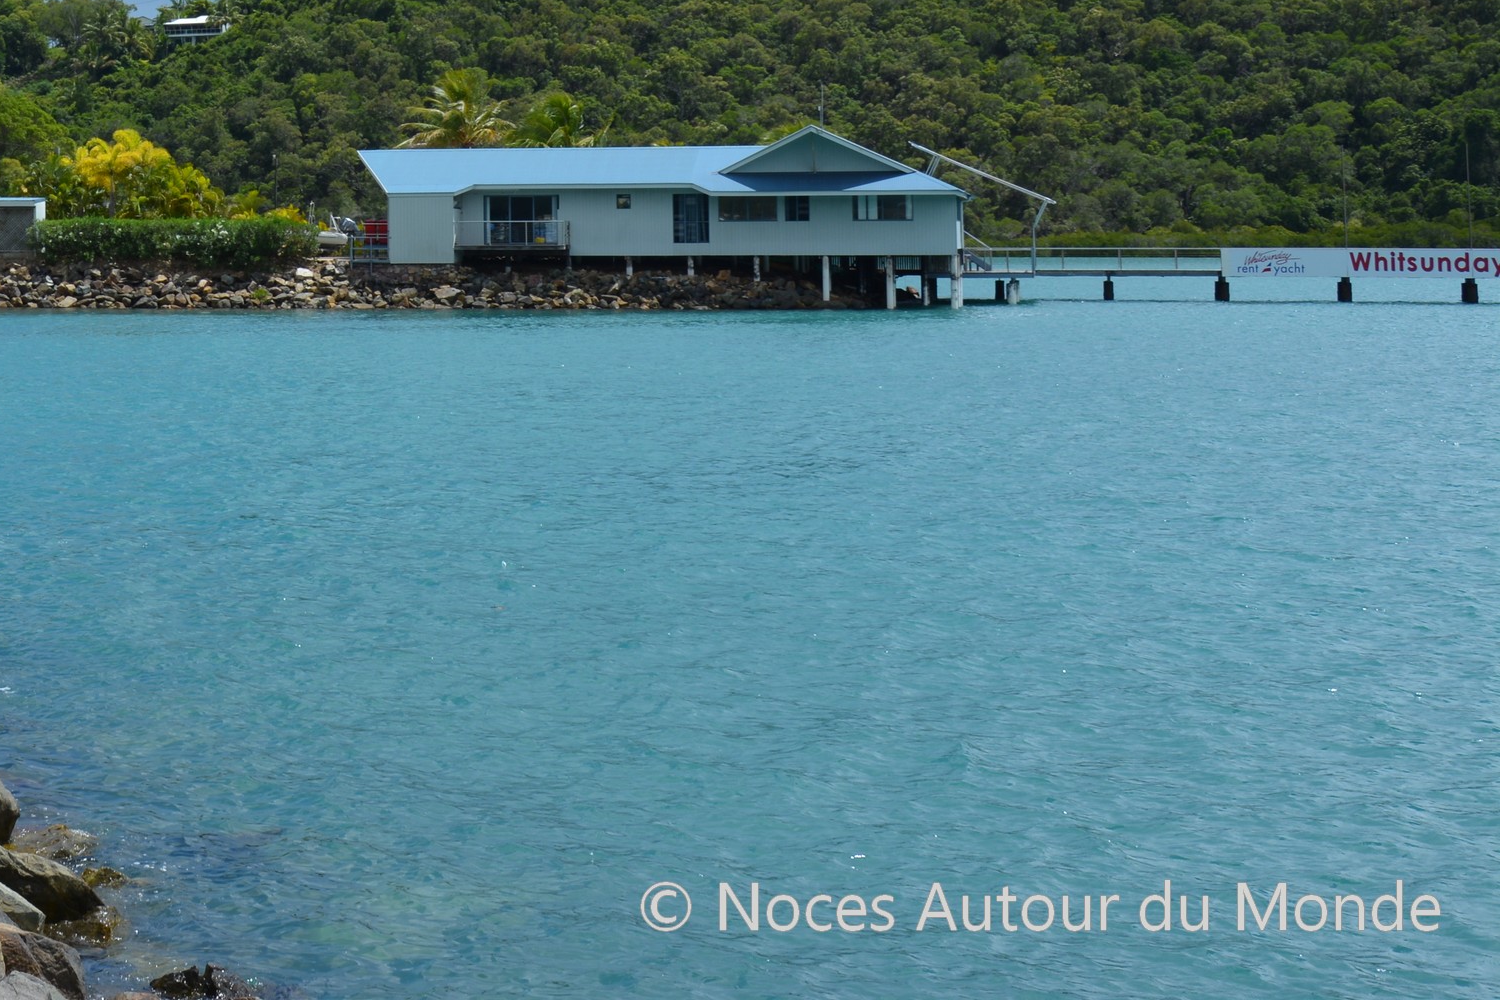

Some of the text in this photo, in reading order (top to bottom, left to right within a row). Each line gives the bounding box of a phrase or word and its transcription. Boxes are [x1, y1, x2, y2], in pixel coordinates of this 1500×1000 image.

[1237, 262, 1306, 276] rent yacht
[1349, 251, 1500, 278] Whitsunday
